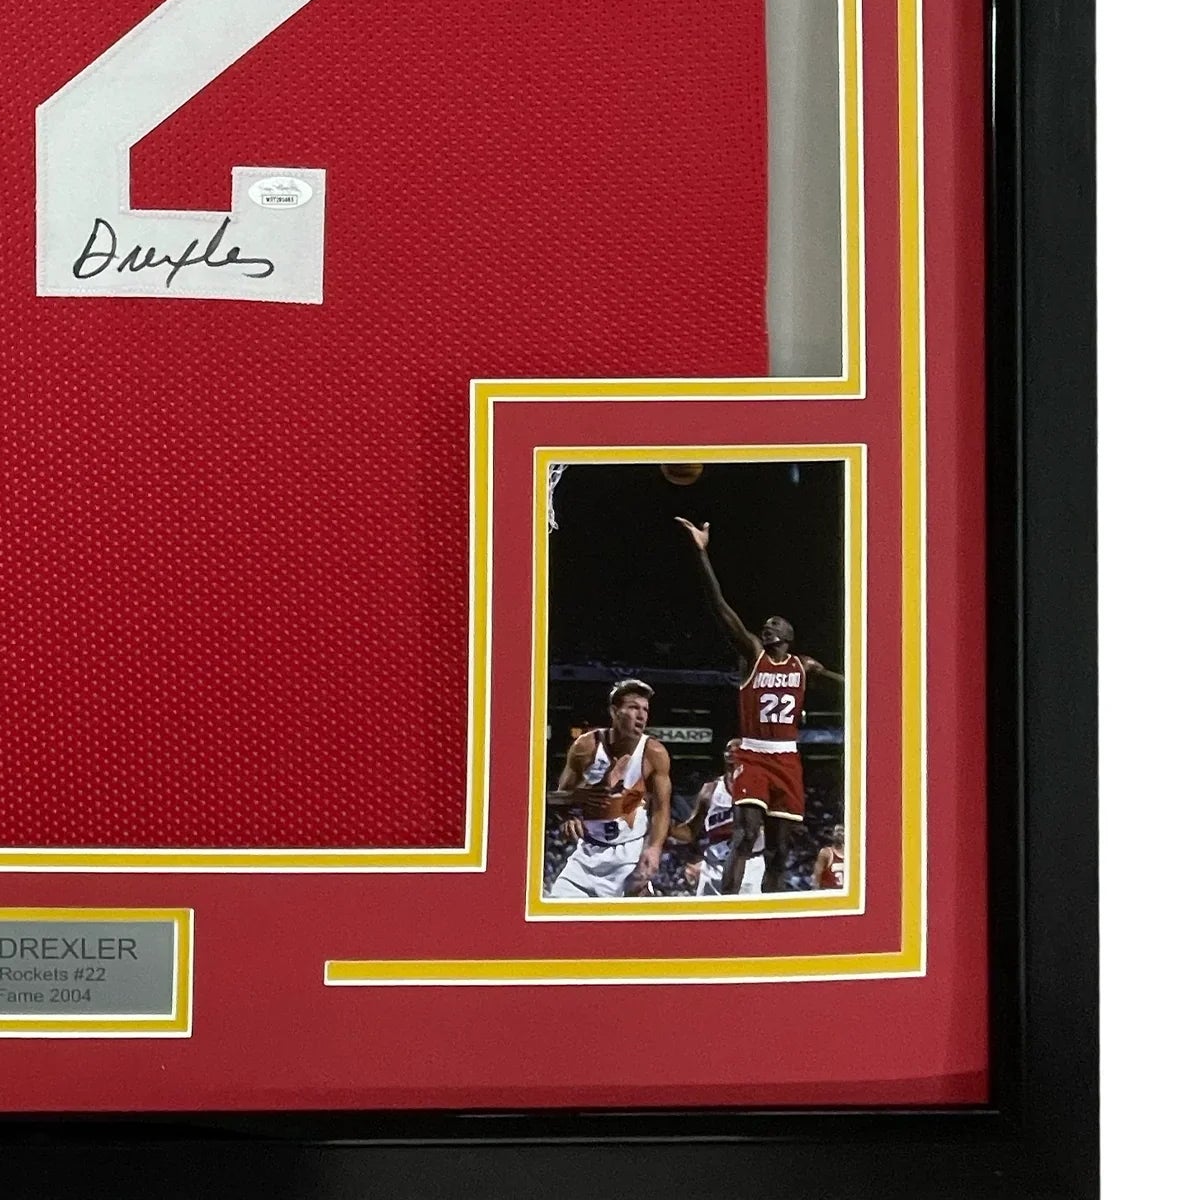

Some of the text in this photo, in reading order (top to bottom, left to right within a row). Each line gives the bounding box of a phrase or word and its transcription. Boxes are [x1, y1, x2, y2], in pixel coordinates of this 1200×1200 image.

[759, 693, 797, 725] 22
[0, 966, 69, 982] Rockets
[73, 967, 106, 982] #22
[50, 988, 92, 1003] 2004
